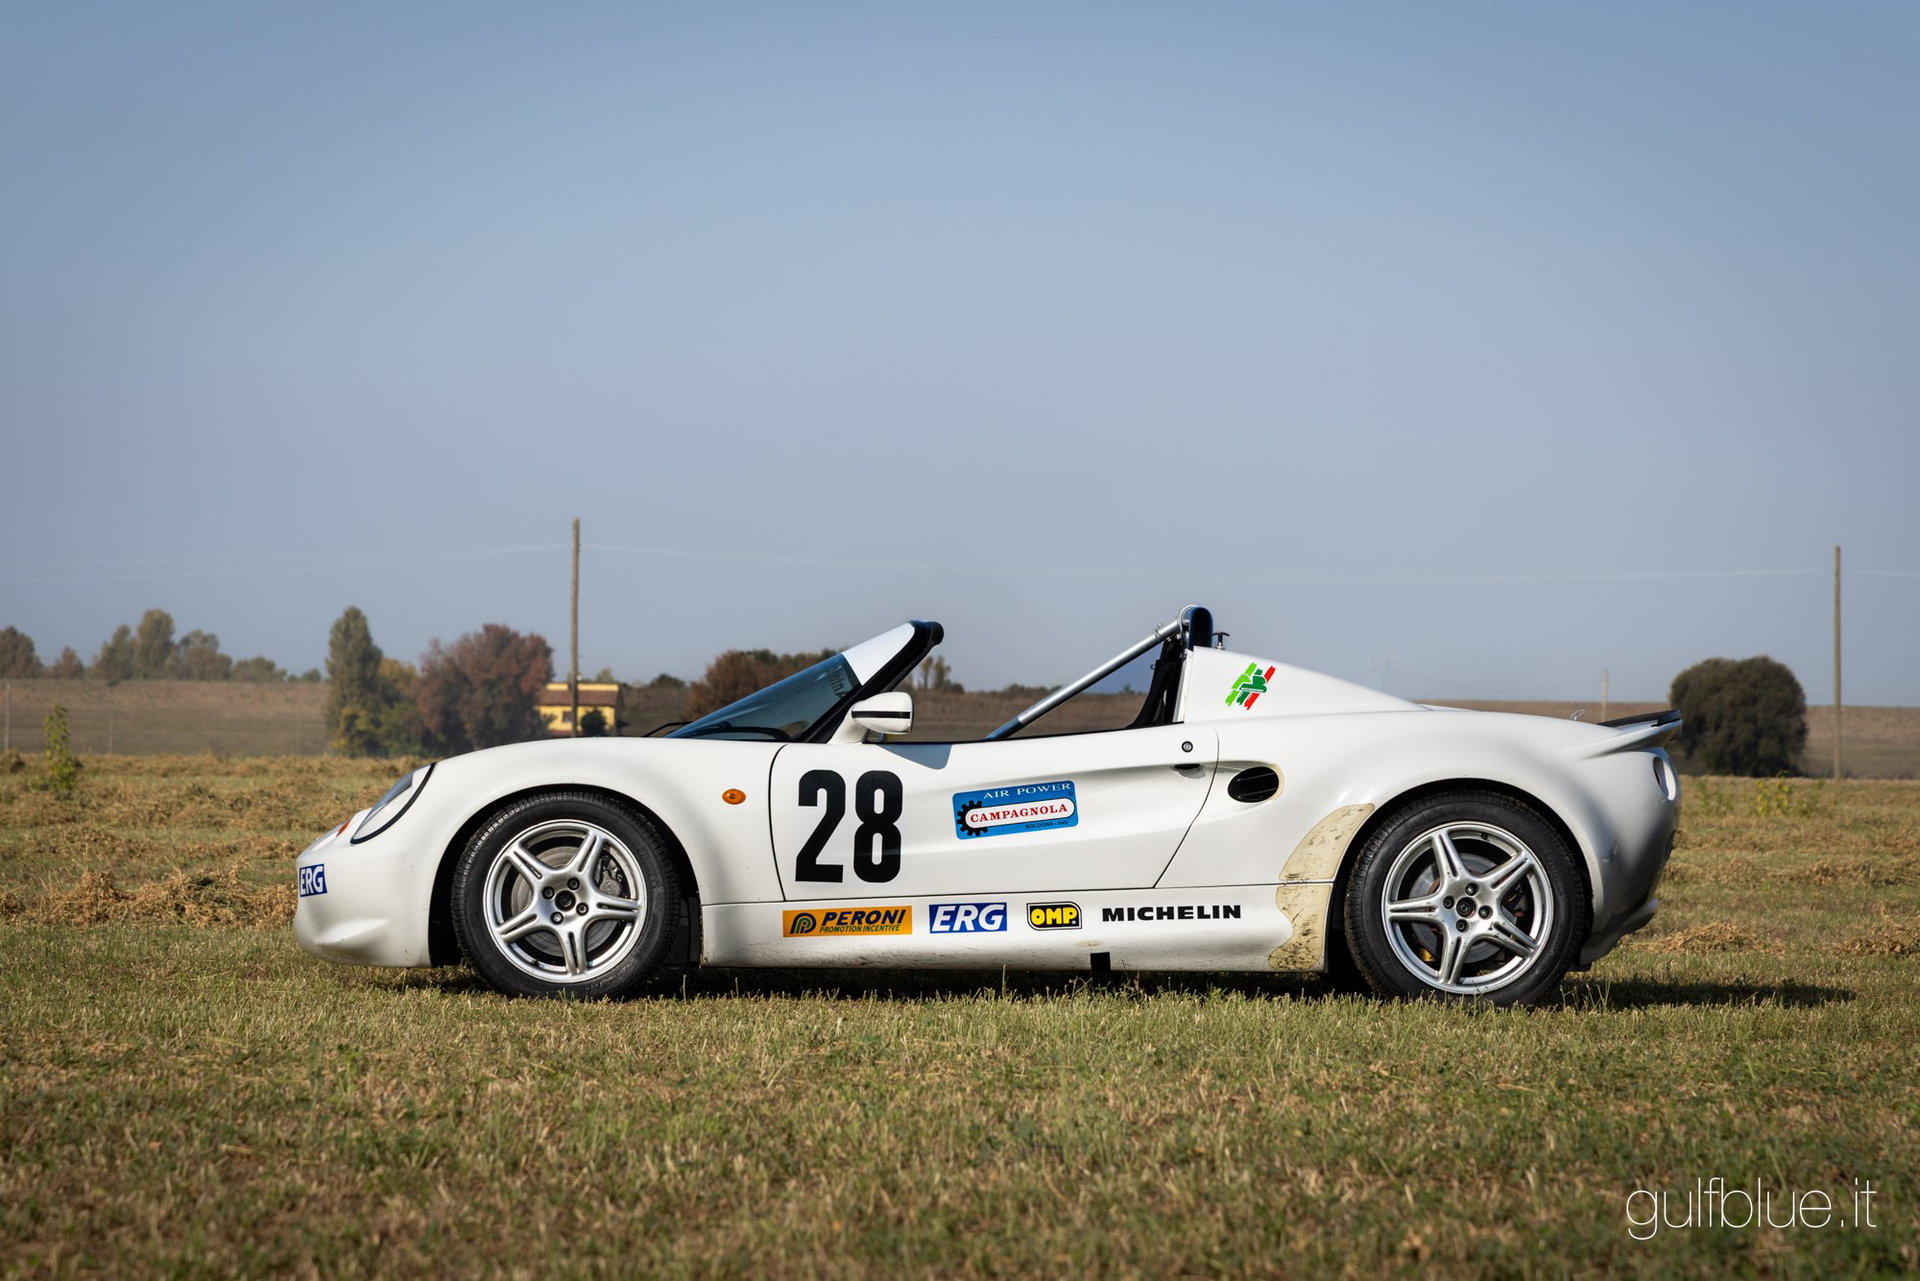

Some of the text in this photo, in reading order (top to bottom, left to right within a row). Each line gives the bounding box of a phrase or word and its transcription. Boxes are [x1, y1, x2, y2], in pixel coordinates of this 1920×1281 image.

[983, 783, 1071, 799] AIR POWER
[970, 803, 1068, 823] CAMPAGNOLA
[795, 769, 903, 883] 28
[300, 866, 323, 895] ERG
[821, 909, 906, 926] PERONI
[931, 904, 1005, 932] ERG
[1030, 907, 1078, 926] OMP
[1102, 905, 1241, 922] MICHELIN
[819, 924, 900, 933] PROMOTION INCENTIVE
